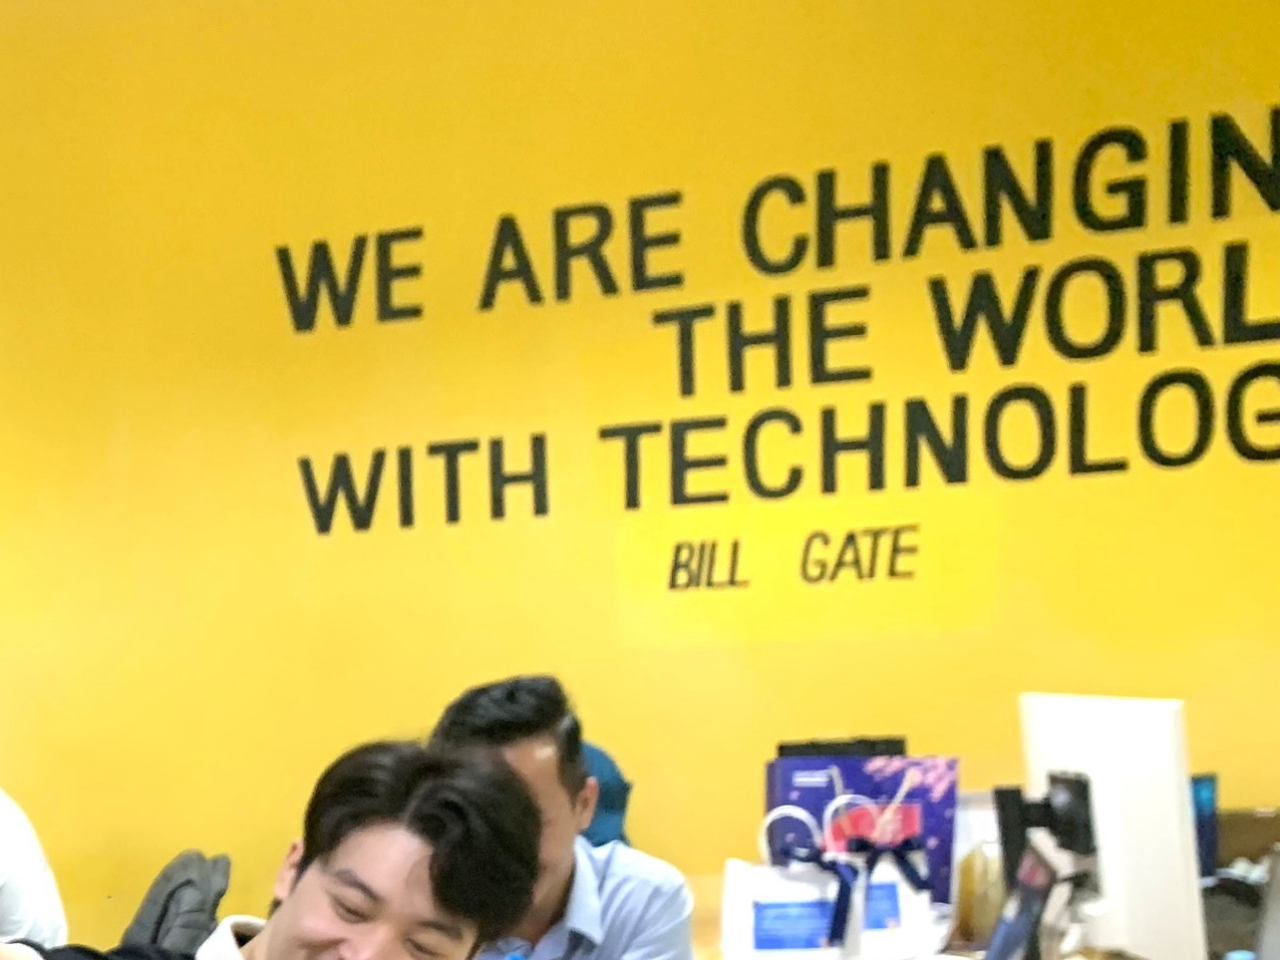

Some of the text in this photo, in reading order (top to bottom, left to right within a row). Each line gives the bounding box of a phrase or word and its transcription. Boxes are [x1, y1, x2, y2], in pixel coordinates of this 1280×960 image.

[275, 104, 1280, 334] WE ARE CHANGIN
[652, 241, 1280, 397] THE WORL
[298, 361, 1280, 534] WITH TECHNOLOG
[668, 524, 921, 591] BILL GATE
